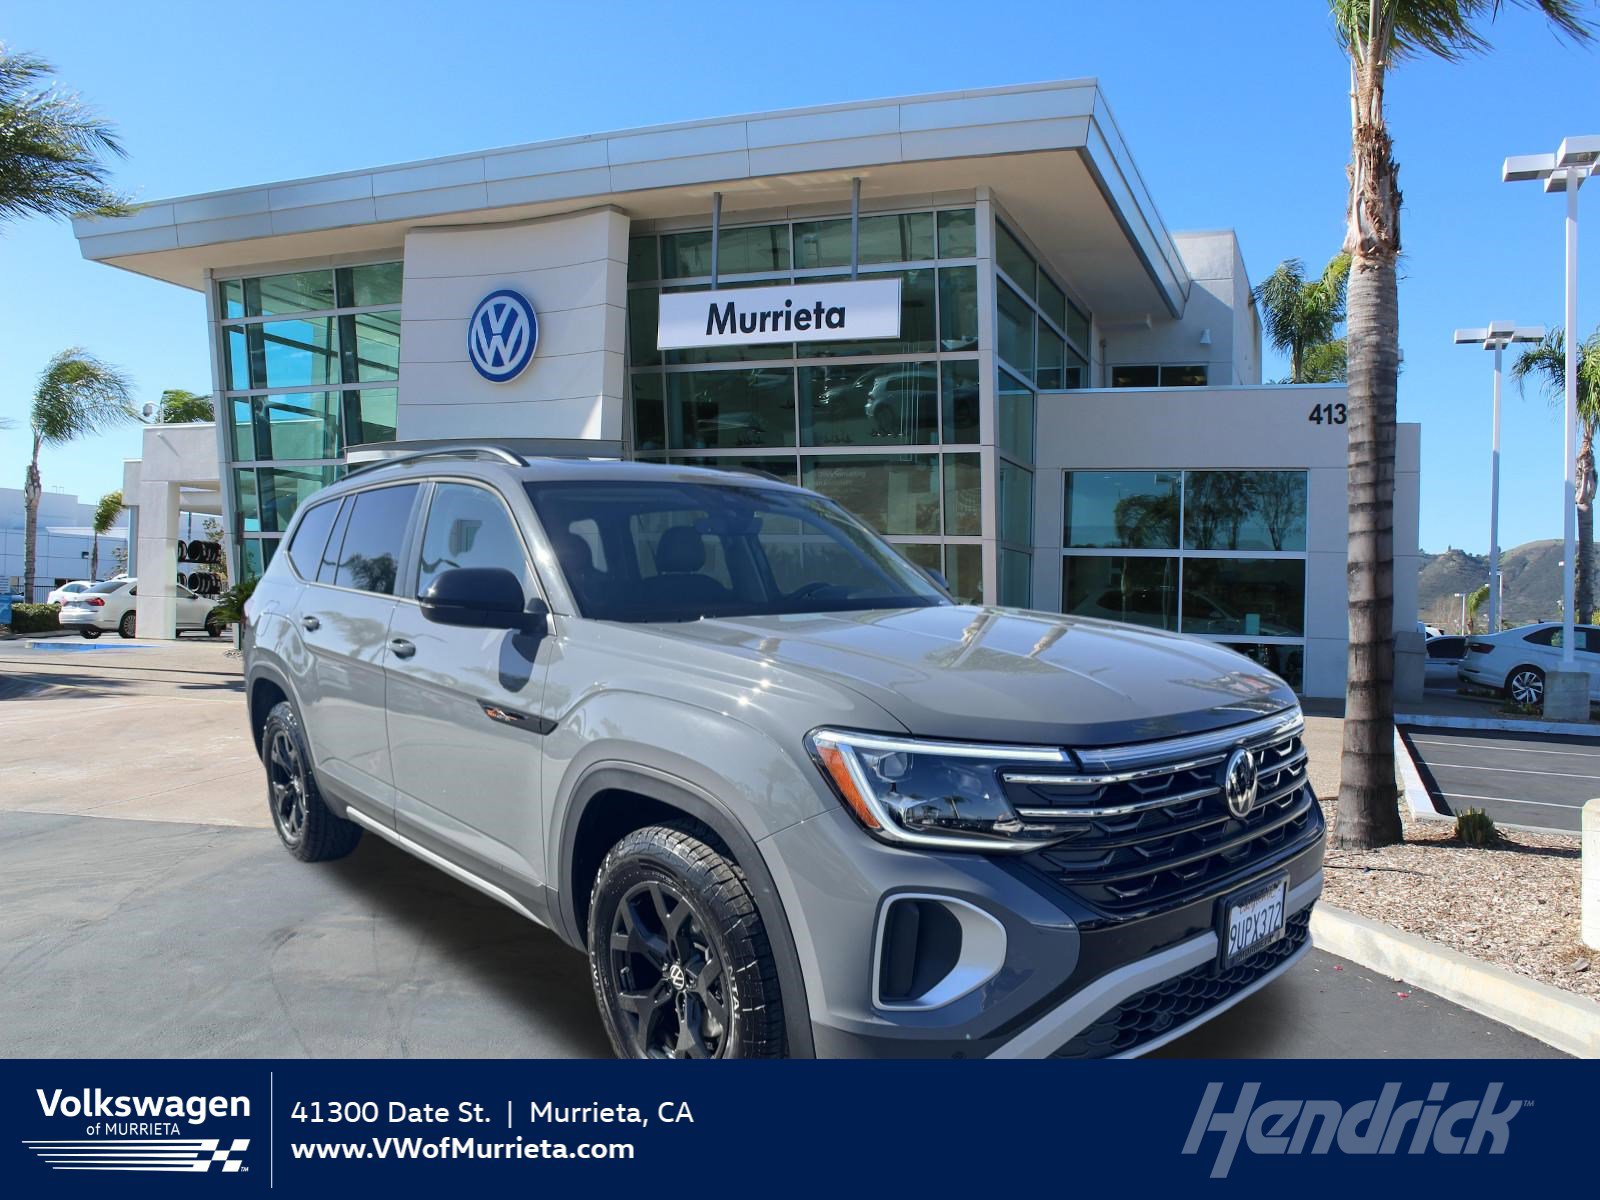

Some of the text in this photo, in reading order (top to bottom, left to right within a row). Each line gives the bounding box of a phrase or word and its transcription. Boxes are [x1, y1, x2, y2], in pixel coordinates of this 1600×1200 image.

[469, 290, 537, 381] VW
[705, 299, 846, 336] Murrieta
[1308, 403, 1347, 425] 413
[1228, 901, 1282, 957] 9UPX372
